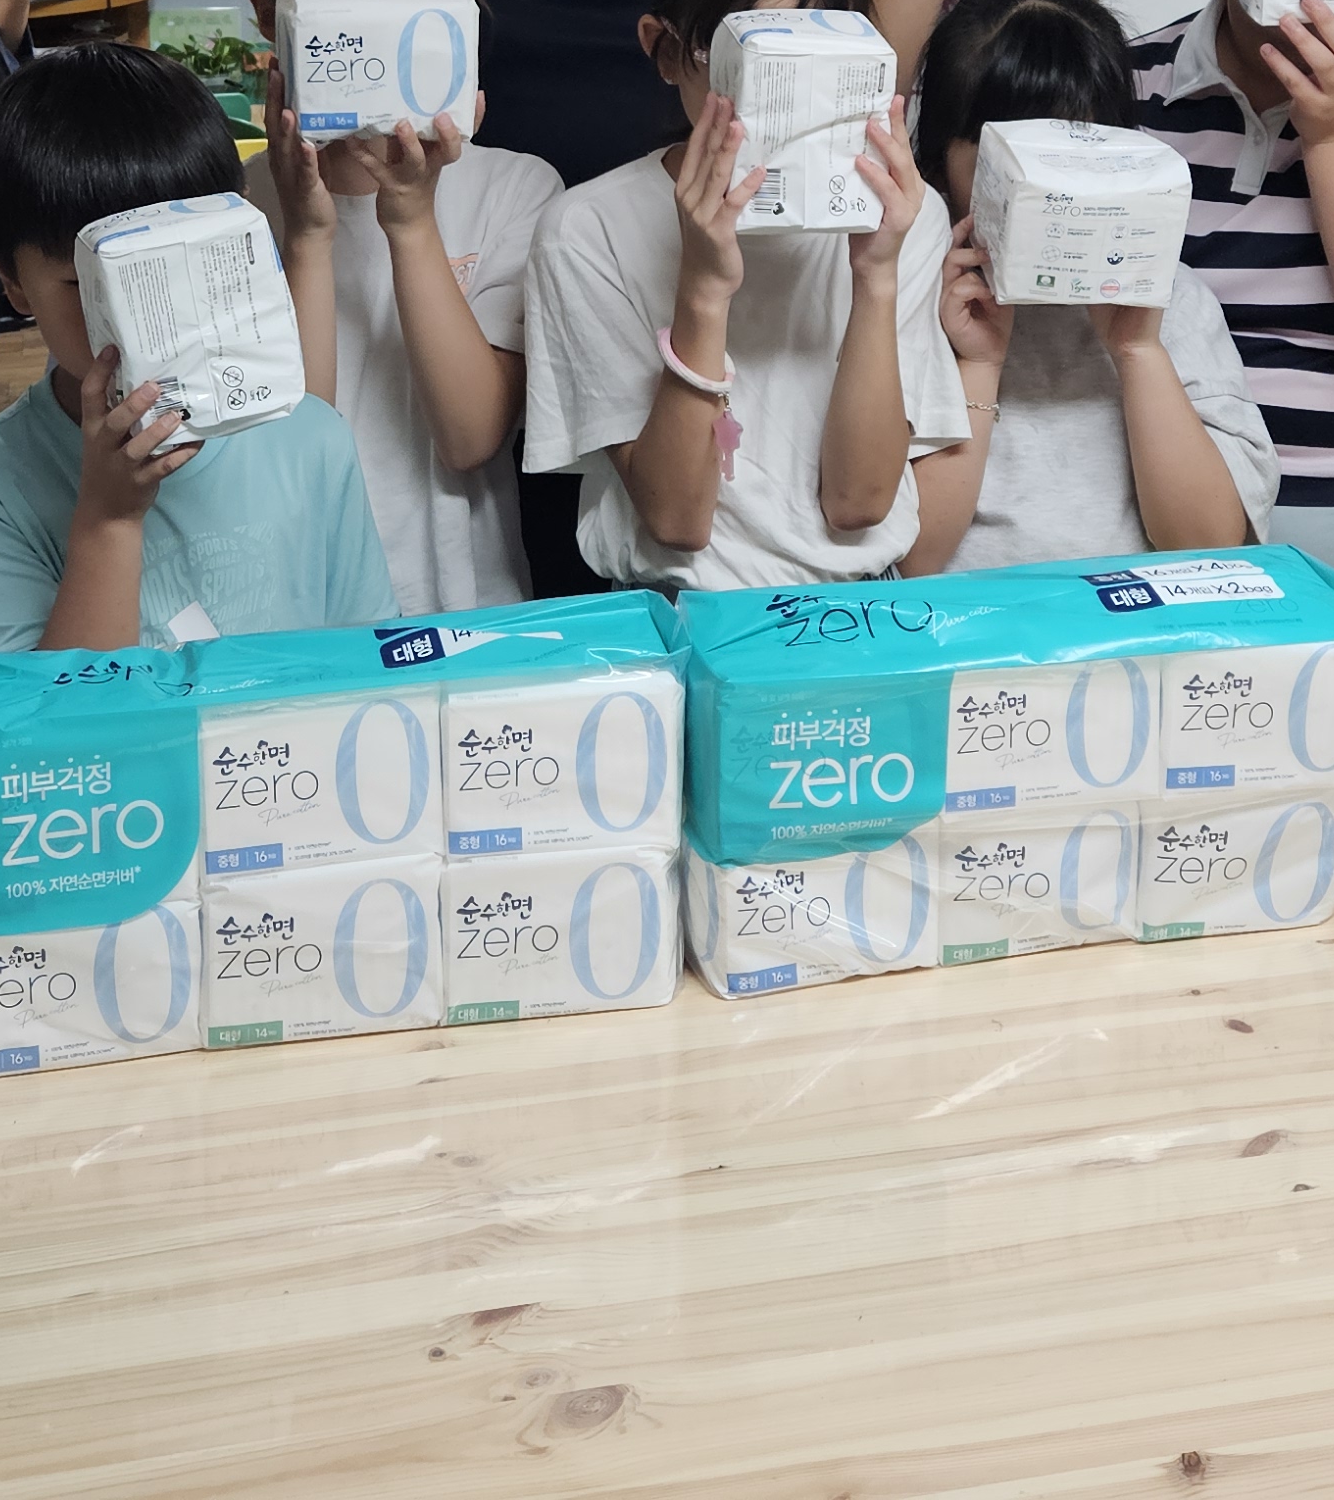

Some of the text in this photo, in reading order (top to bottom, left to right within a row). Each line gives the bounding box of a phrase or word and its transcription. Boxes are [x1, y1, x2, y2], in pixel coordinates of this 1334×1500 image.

[305, 33, 363, 57] 순수한면
[307, 58, 385, 83] zero
[1042, 202, 1081, 217] zero
[1109, 586, 1151, 607] 대형
[392, 634, 433, 662] 대형
[1183, 672, 1252, 700] 순수한면
[957, 691, 1026, 723] 순수한면
[1181, 702, 1273, 731] zero
[458, 724, 532, 757] 순수한면
[771, 715, 871, 751] 피부걱정
[957, 719, 1051, 754] zero
[213, 740, 290, 776] 순수한면
[459, 757, 559, 791] zero
[1, 761, 112, 804] 피부걱정
[215, 770, 318, 810] zero
[769, 753, 914, 809] zero
[2, 800, 164, 866] zero
[771, 825, 808, 840] 100%
[1157, 825, 1228, 852] 순수한면
[955, 843, 1025, 872] 순수한면
[1154, 856, 1247, 884] zero
[5, 878, 46, 899] 100%
[953, 872, 1050, 901] zero
[456, 892, 532, 925] 순수한면
[737, 897, 830, 936] zero
[216, 913, 294, 945] 순수한면
[457, 925, 558, 959] zero
[217, 944, 322, 979] zero
